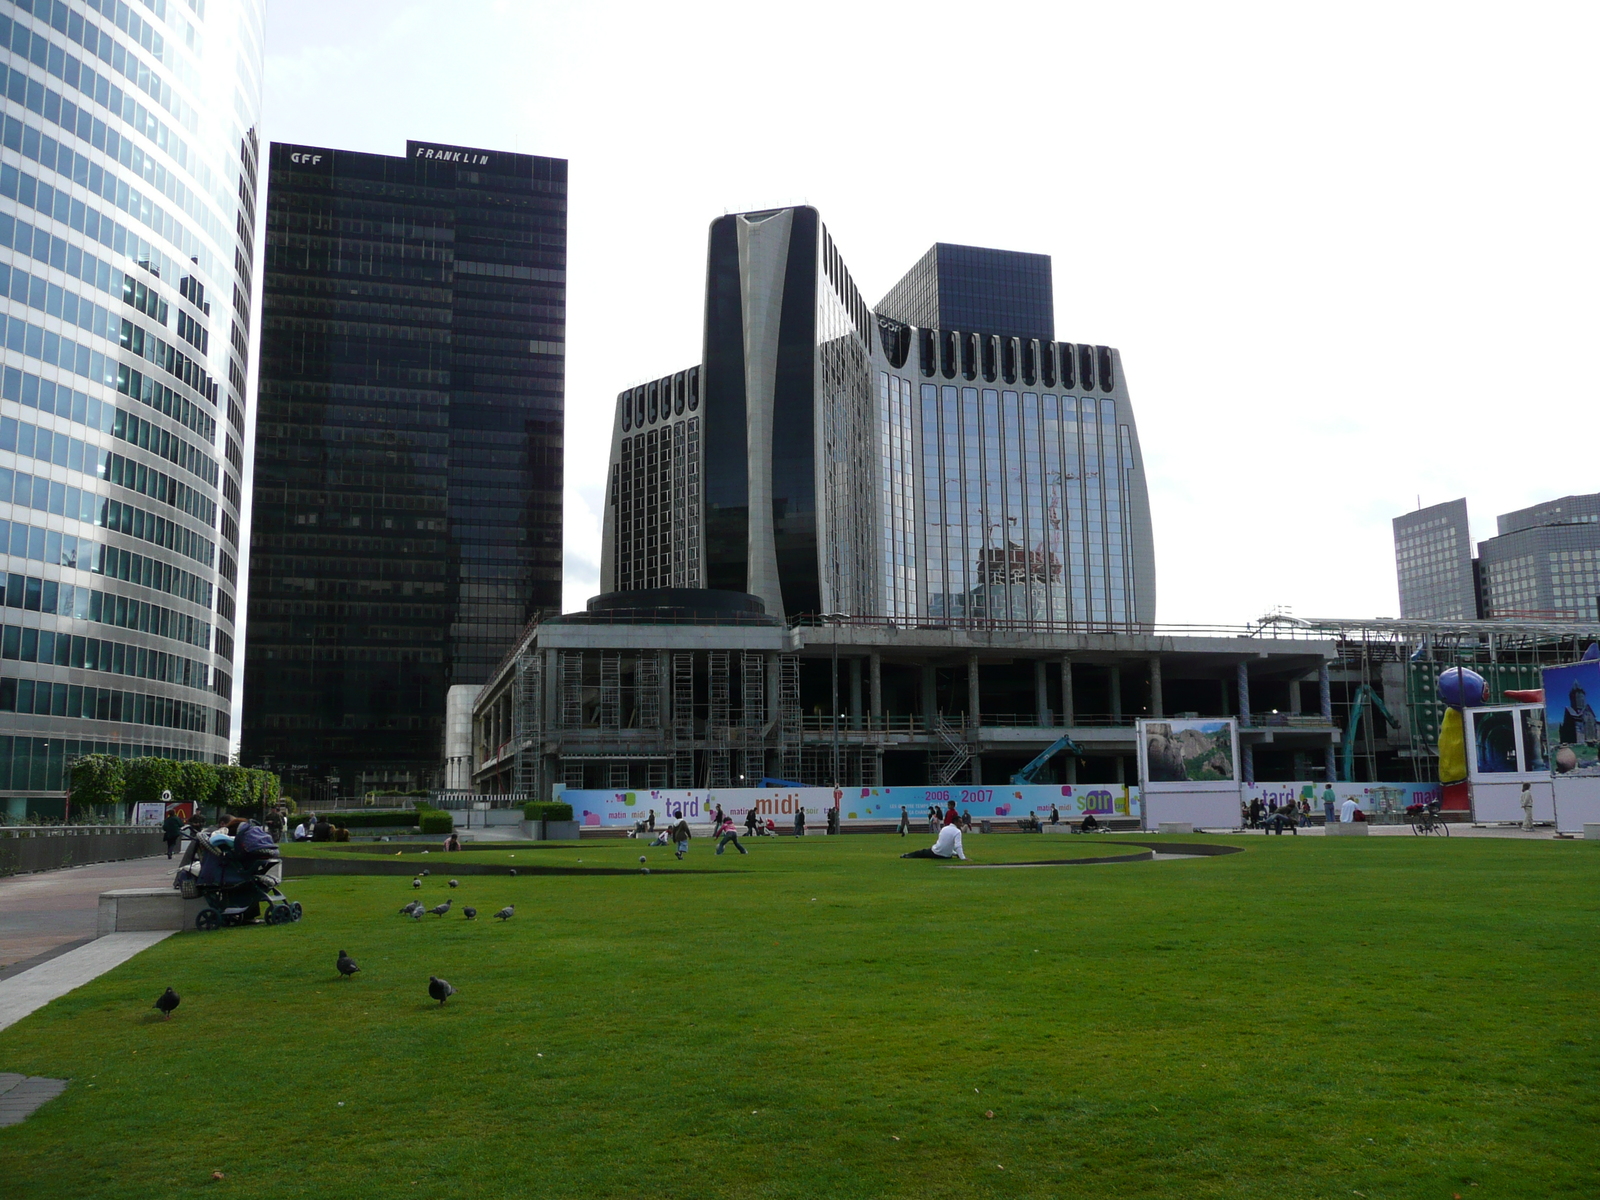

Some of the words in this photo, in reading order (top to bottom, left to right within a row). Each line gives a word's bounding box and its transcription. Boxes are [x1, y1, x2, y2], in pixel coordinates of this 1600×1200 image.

[291, 153, 322, 165] GFF
[416, 147, 489, 165] FRANKLIN
[756, 794, 798, 814] midi
[925, 791, 950, 801] 2006
[961, 790, 993, 802] 2007
[1076, 790, 1111, 811] soir
[1262, 788, 1294, 806] tard
[608, 811, 626, 819] matin
[666, 797, 698, 817] tard
